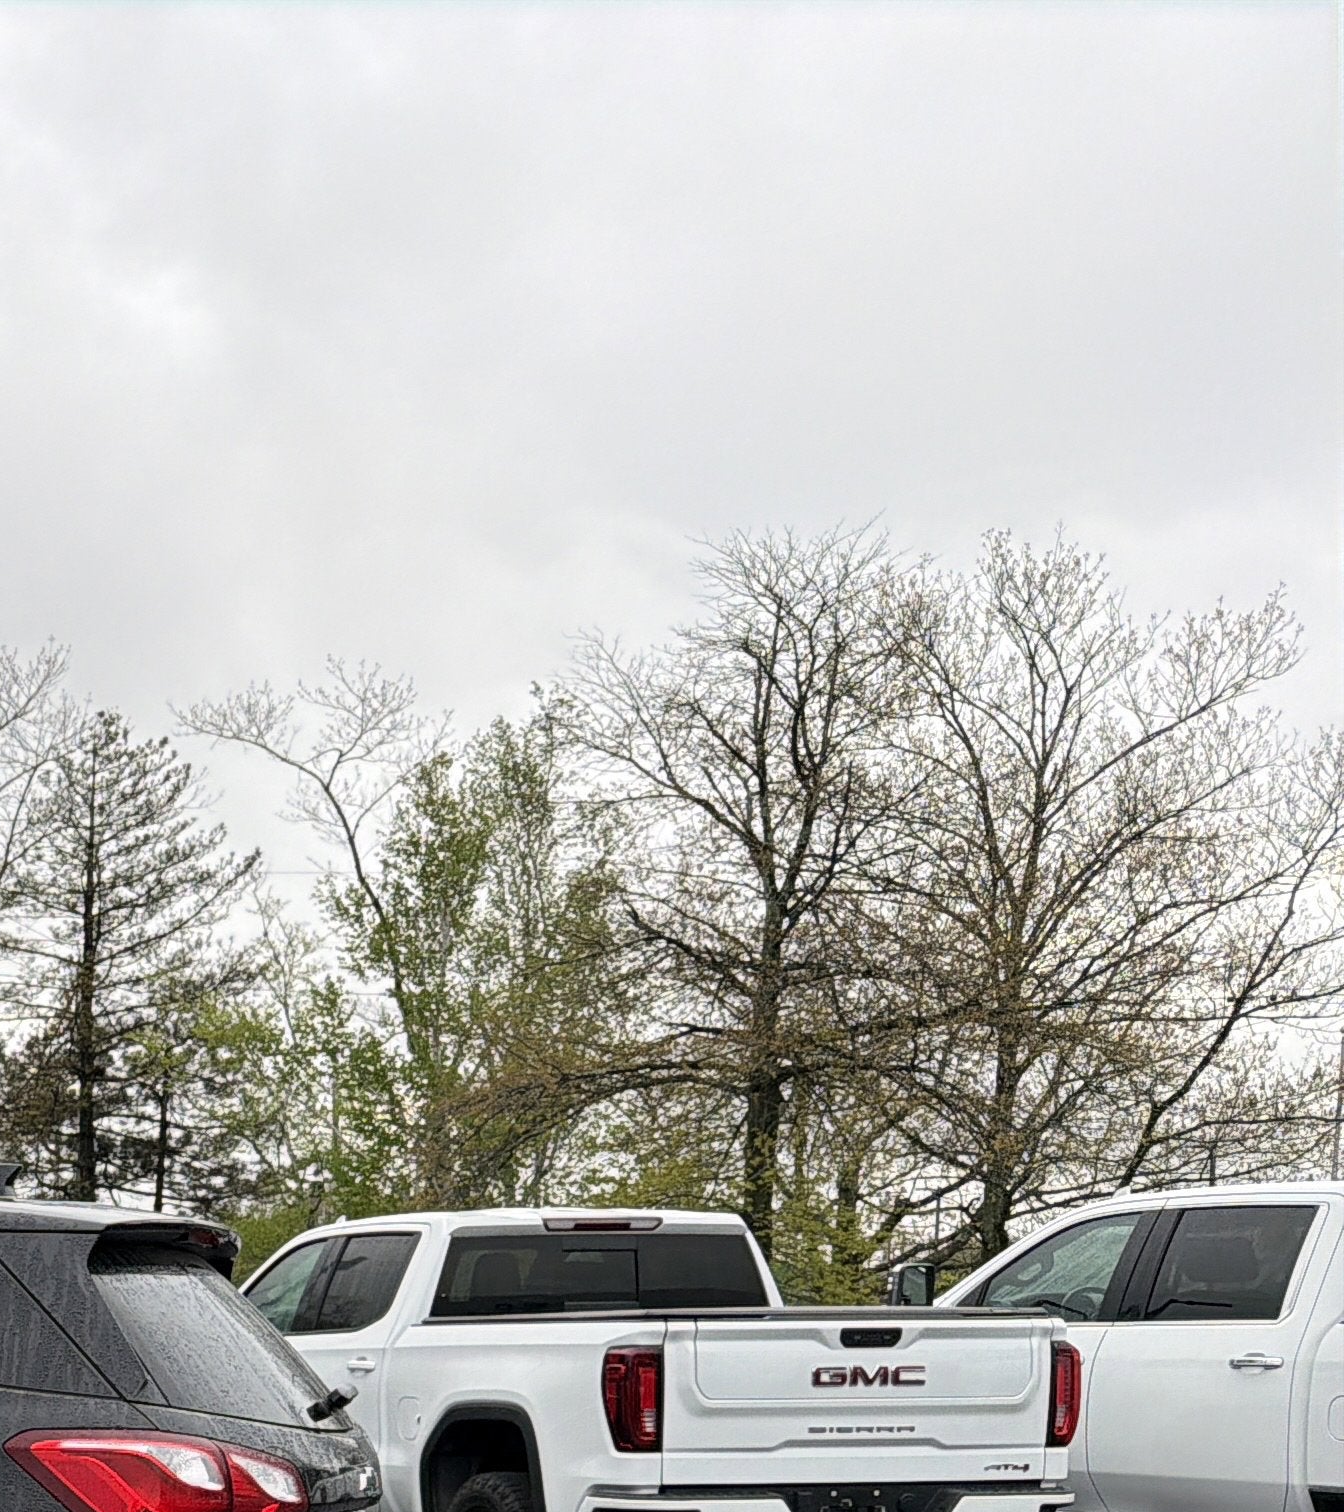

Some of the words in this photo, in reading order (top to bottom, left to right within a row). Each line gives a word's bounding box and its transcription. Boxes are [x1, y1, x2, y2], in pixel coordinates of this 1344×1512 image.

[811, 1365, 926, 1388] GMC
[808, 1425, 916, 1434] SIERRA
[984, 1463, 1030, 1473] AT4
